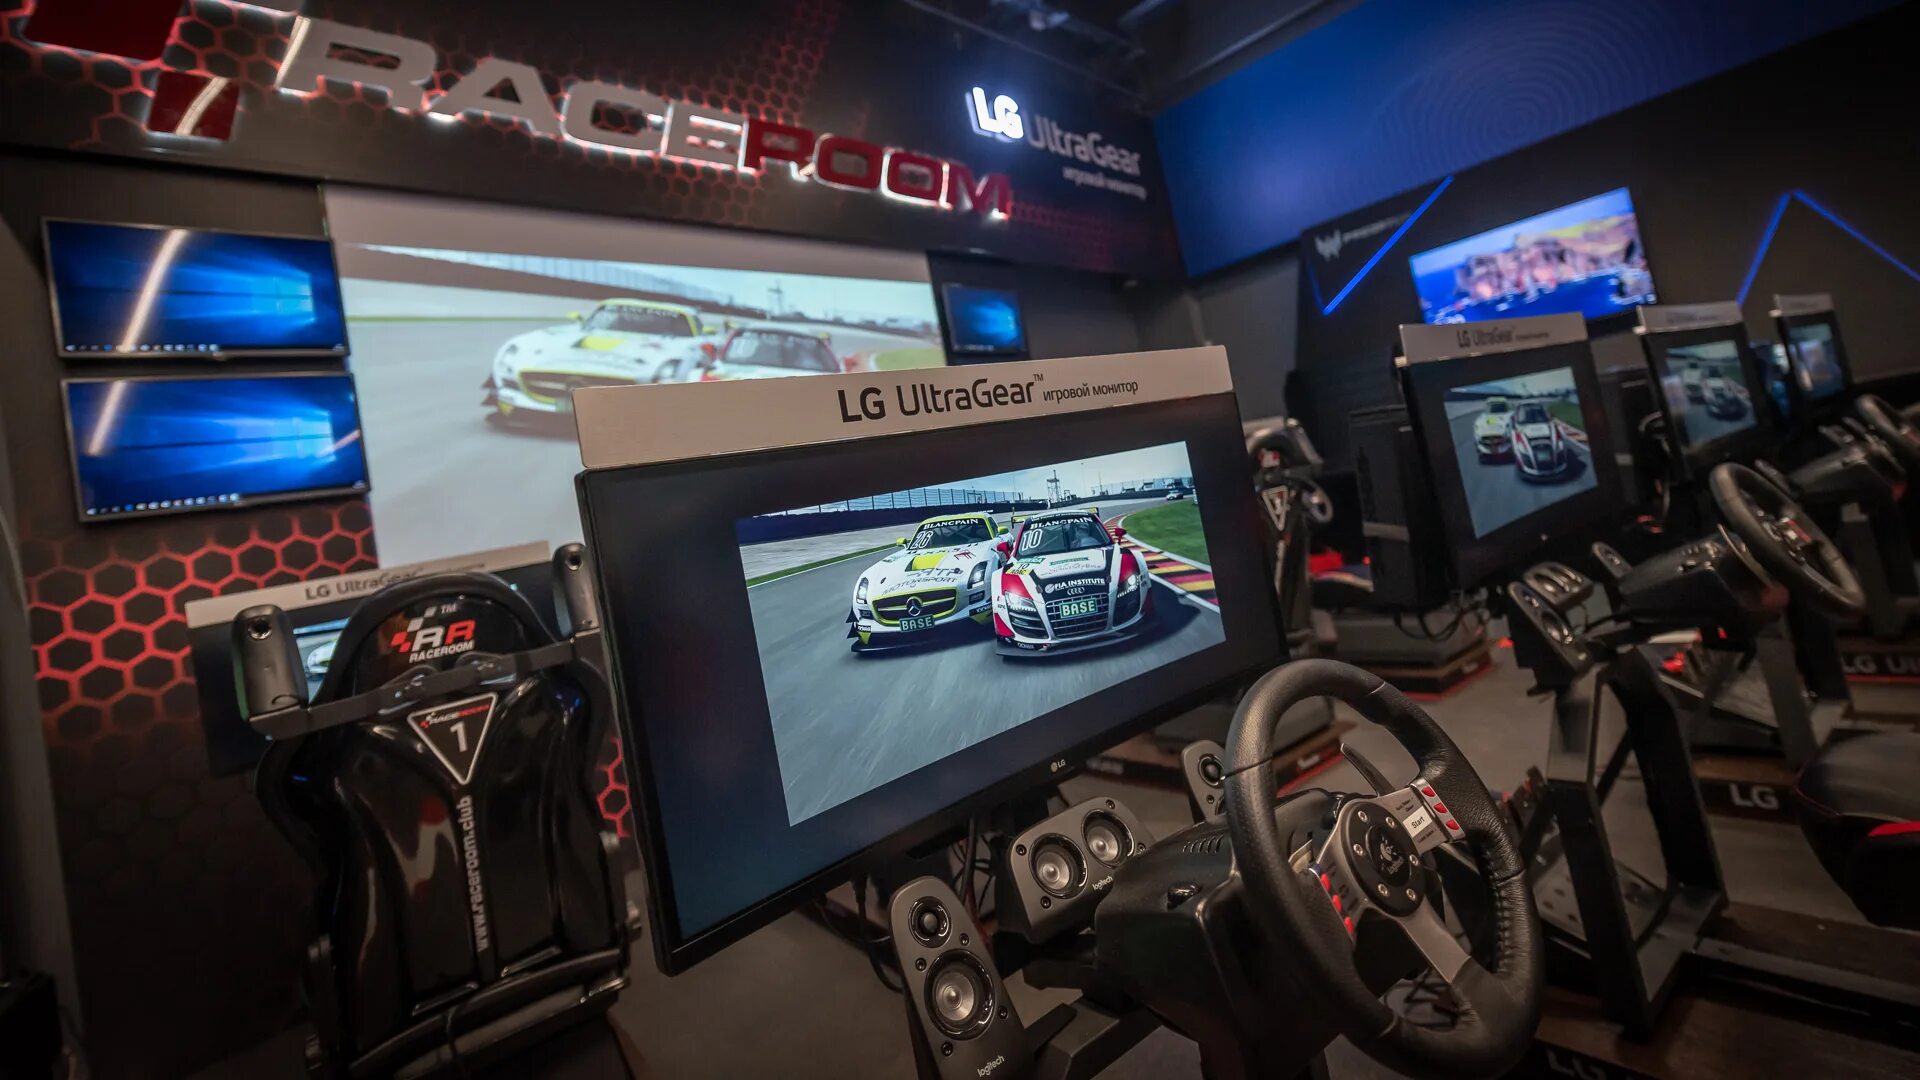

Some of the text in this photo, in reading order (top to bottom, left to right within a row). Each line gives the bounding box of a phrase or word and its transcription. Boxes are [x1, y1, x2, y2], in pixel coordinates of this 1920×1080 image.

[274, 14, 1013, 220] RACEROOM
[968, 86, 1142, 176] LG UltraGear
[837, 387, 887, 423] LG
[1042, 382, 1091, 404] игровой
[1092, 381, 1139, 396] монитор
[923, 518, 979, 531] BLANCPAIN
[1029, 516, 1094, 530] BLANCPAIN
[910, 530, 934, 549] 26
[1021, 528, 1043, 552] 10
[304, 584, 331, 600] LG
[1054, 577, 1106, 591] FIA INSTITUTE
[1062, 600, 1096, 616] BASE
[901, 616, 934, 631] BASE
[409, 639, 475, 664] RACEROOM
[1840, 654, 1878, 674] LG
[449, 721, 468, 752] 1
[1729, 782, 1779, 810] LG
[1411, 816, 1426, 829] Start
[456, 795, 489, 952] www.raceroom.club
[976, 1055, 1005, 1078] logitech
